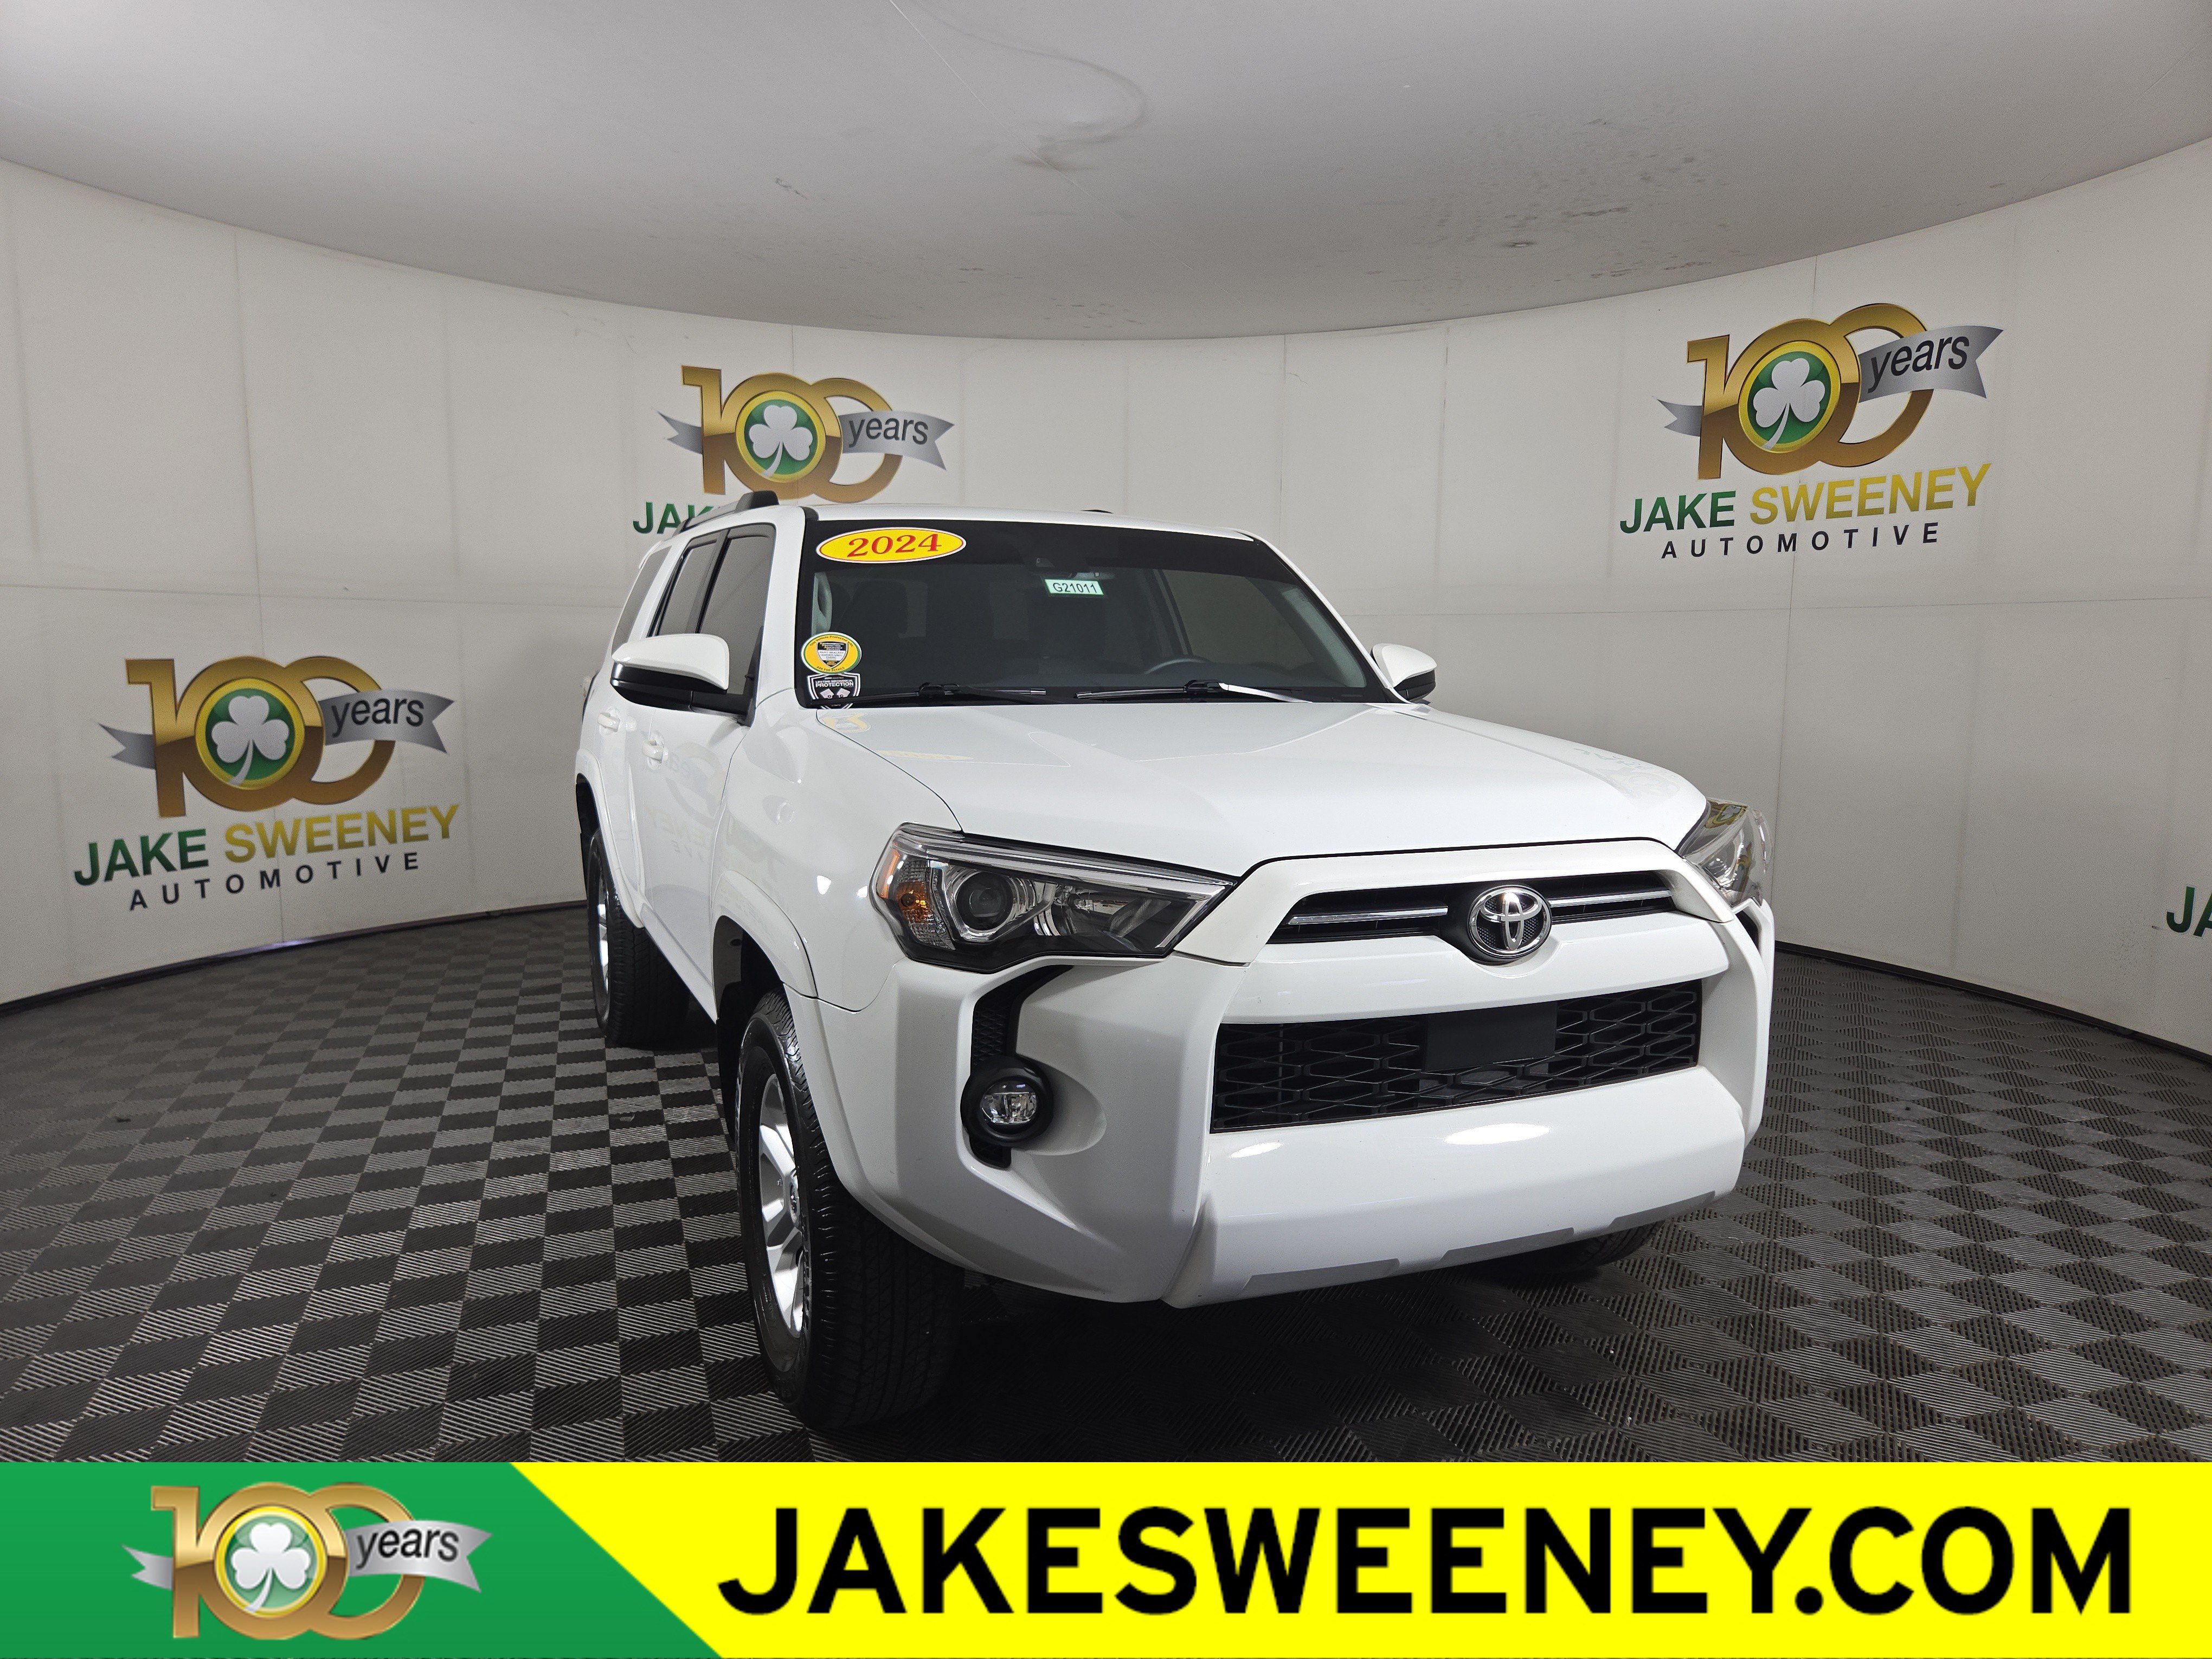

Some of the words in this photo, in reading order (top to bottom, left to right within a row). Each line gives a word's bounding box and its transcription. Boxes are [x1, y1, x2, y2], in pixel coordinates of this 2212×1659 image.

[1687, 303, 1934, 480] 100
[1867, 334, 1970, 394] years
[681, 365, 903, 503] 100
[847, 415, 929, 448] years
[1619, 490, 1736, 535] JAKE
[1750, 462, 1992, 525] SWEENEY
[846, 533, 942, 558] 2024
[1661, 522, 1938, 559] AUTOMOTIVE
[1053, 582, 1097, 594] G21011
[125, 655, 396, 819] 100
[330, 697, 425, 737] years
[74, 828, 209, 886] JAKE
[224, 805, 460, 864] SWEENEY
[129, 852, 419, 911] AUTOMOTIVE
